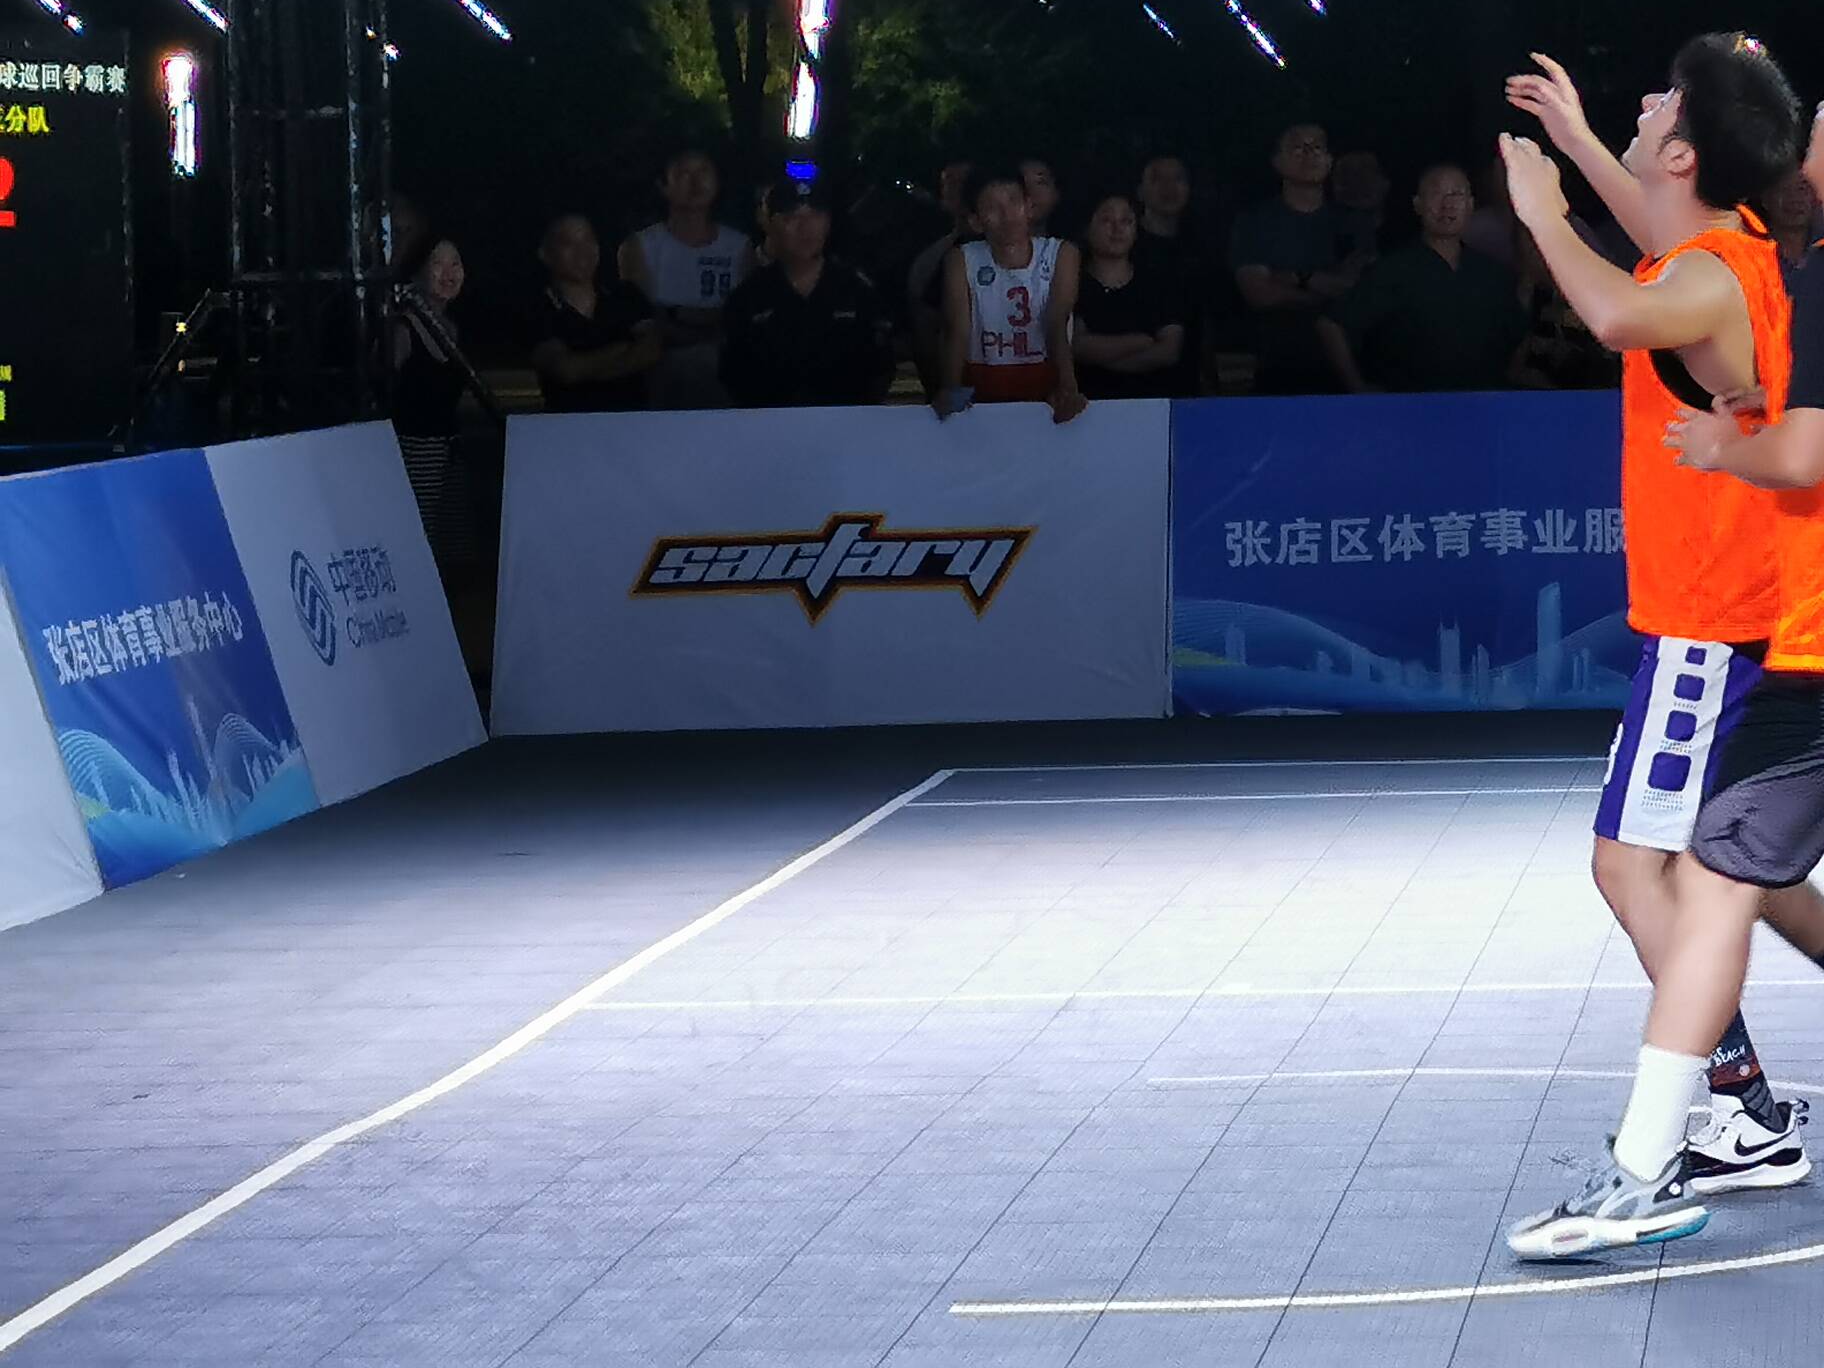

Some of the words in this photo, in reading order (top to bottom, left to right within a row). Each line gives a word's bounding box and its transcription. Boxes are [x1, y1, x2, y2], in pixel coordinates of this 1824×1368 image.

[1006, 285, 1032, 328] 3
[1224, 507, 1625, 569] 张店区体育事业服
[43, 591, 244, 686] 张店区体育事业服务中心
